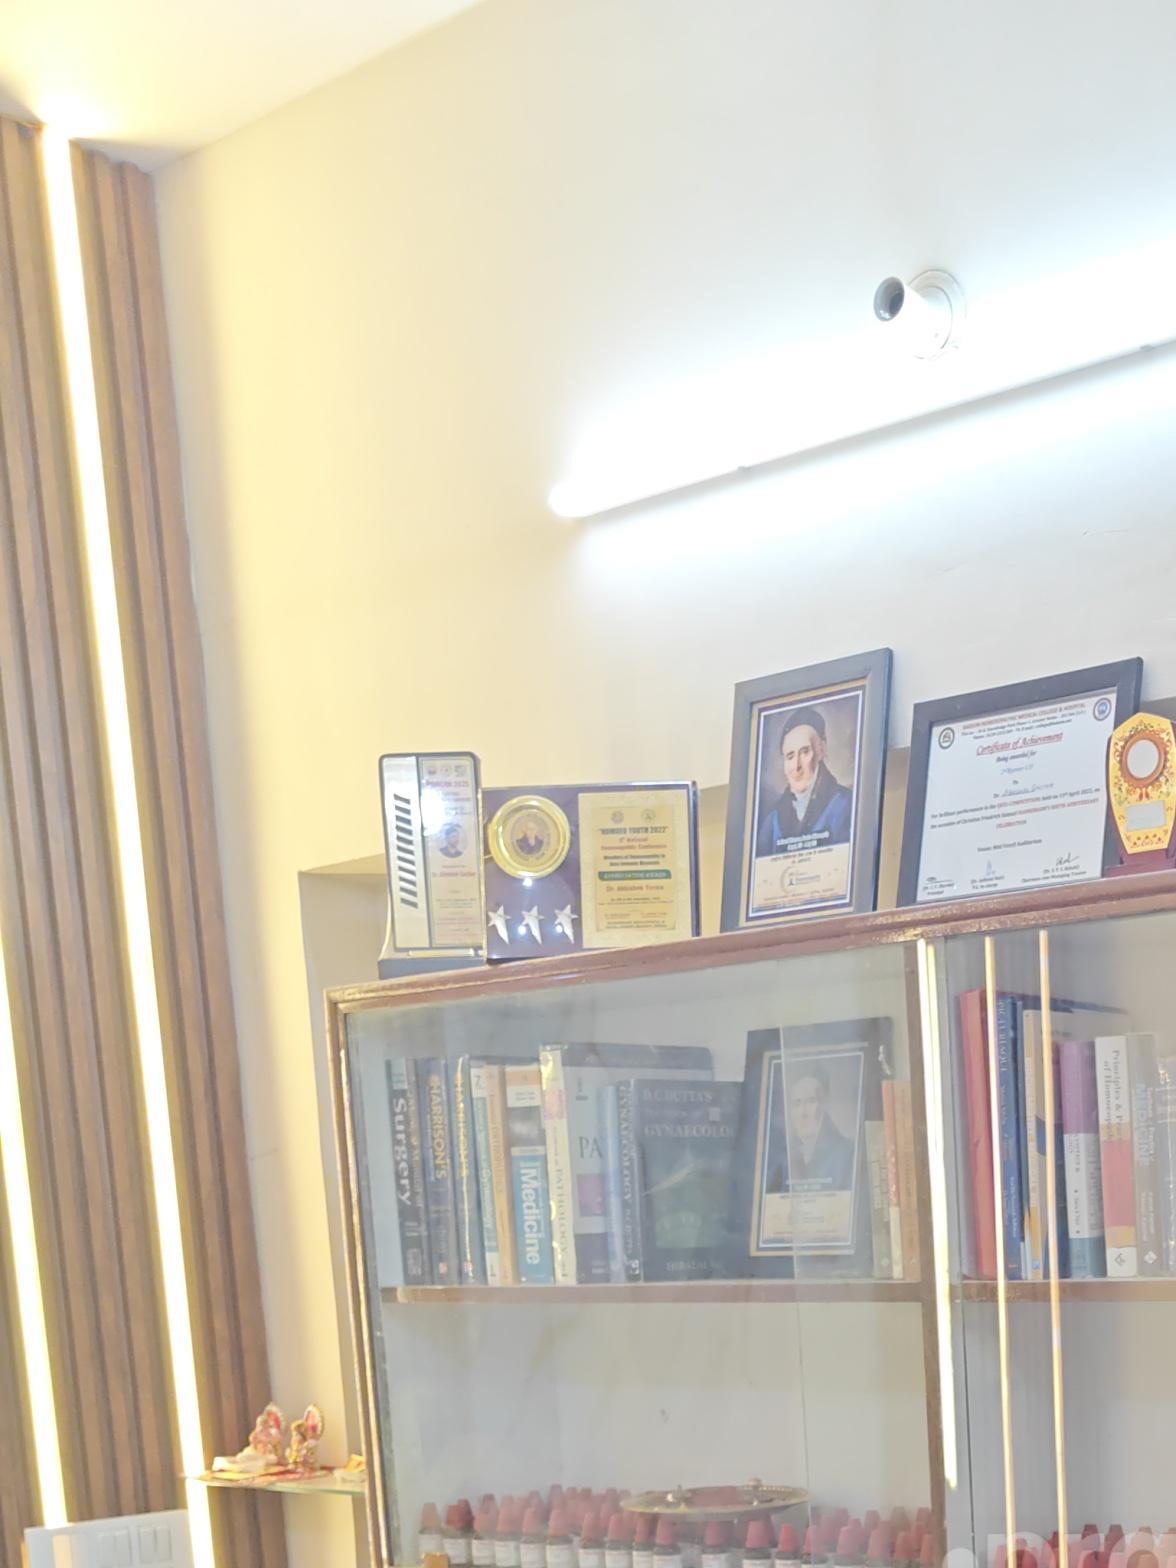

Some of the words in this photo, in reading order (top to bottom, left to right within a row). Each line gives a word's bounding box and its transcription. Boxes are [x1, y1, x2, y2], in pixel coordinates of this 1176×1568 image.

[1112, 1049, 1122, 1101] Principles
[393, 1097, 413, 1206] Surgery
[429, 1083, 448, 1179] HARRISON'S
[519, 1168, 544, 1265] Medicine
